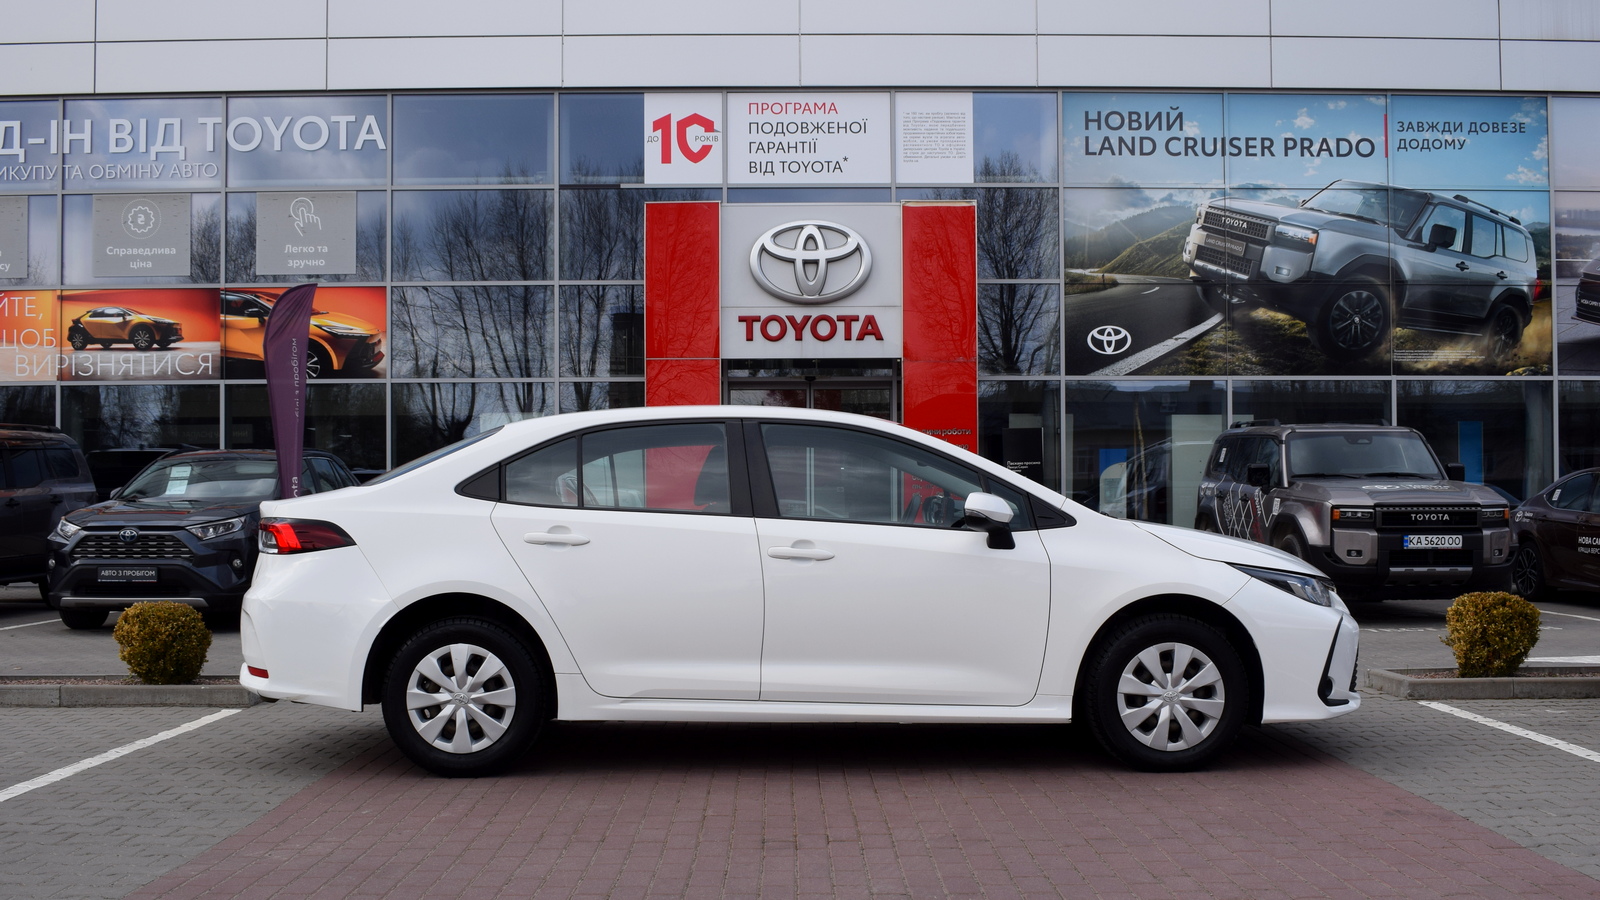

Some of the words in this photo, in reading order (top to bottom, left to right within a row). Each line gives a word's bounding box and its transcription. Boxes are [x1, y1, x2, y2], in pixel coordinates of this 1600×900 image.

[748, 102, 839, 115] ПРОГРАМА
[1084, 105, 1184, 132] НОВИЙ
[748, 118, 868, 136] ПОДОВЖЕНОЇ
[1396, 120, 1464, 136] ЗАВЖДИ
[1467, 120, 1527, 136] ДОВЕЗЕ
[108, 117, 187, 161] ВІД
[198, 114, 387, 152] TOYOTA
[646, 135, 660, 144] ДО
[694, 134, 719, 143] РОКІВ
[749, 138, 818, 154] ГАРАНТІЇ
[1084, 136, 1157, 158] LAND
[1164, 136, 1276, 159] CRUISER
[1283, 137, 1376, 159] PRADO
[1396, 138, 1467, 153] ДОДОМУ
[63, 164, 84, 179] ТА
[88, 163, 165, 180] ОБМІНУ
[168, 162, 219, 178] АВТО
[749, 160, 775, 176] ВІД
[1221, 217, 1247, 229] TOYOTA
[105, 246, 177, 258] Справедлива
[284, 243, 314, 254] Легко
[316, 245, 329, 254] та
[129, 259, 153, 271] ціна
[286, 258, 326, 269] зручно
[738, 314, 884, 342] TOYOTA
[15, 353, 213, 377] ВИРІЗНЯТИСЯ
[942, 428, 971, 436] роботи
[1410, 513, 1450, 521] TOYOTA
[1408, 536, 1423, 546] KA
[1424, 536, 1446, 546] 5620
[100, 569, 117, 577] АВТО
[118, 569, 123, 577] З
[123, 569, 156, 577] ПРОБІГОМ
